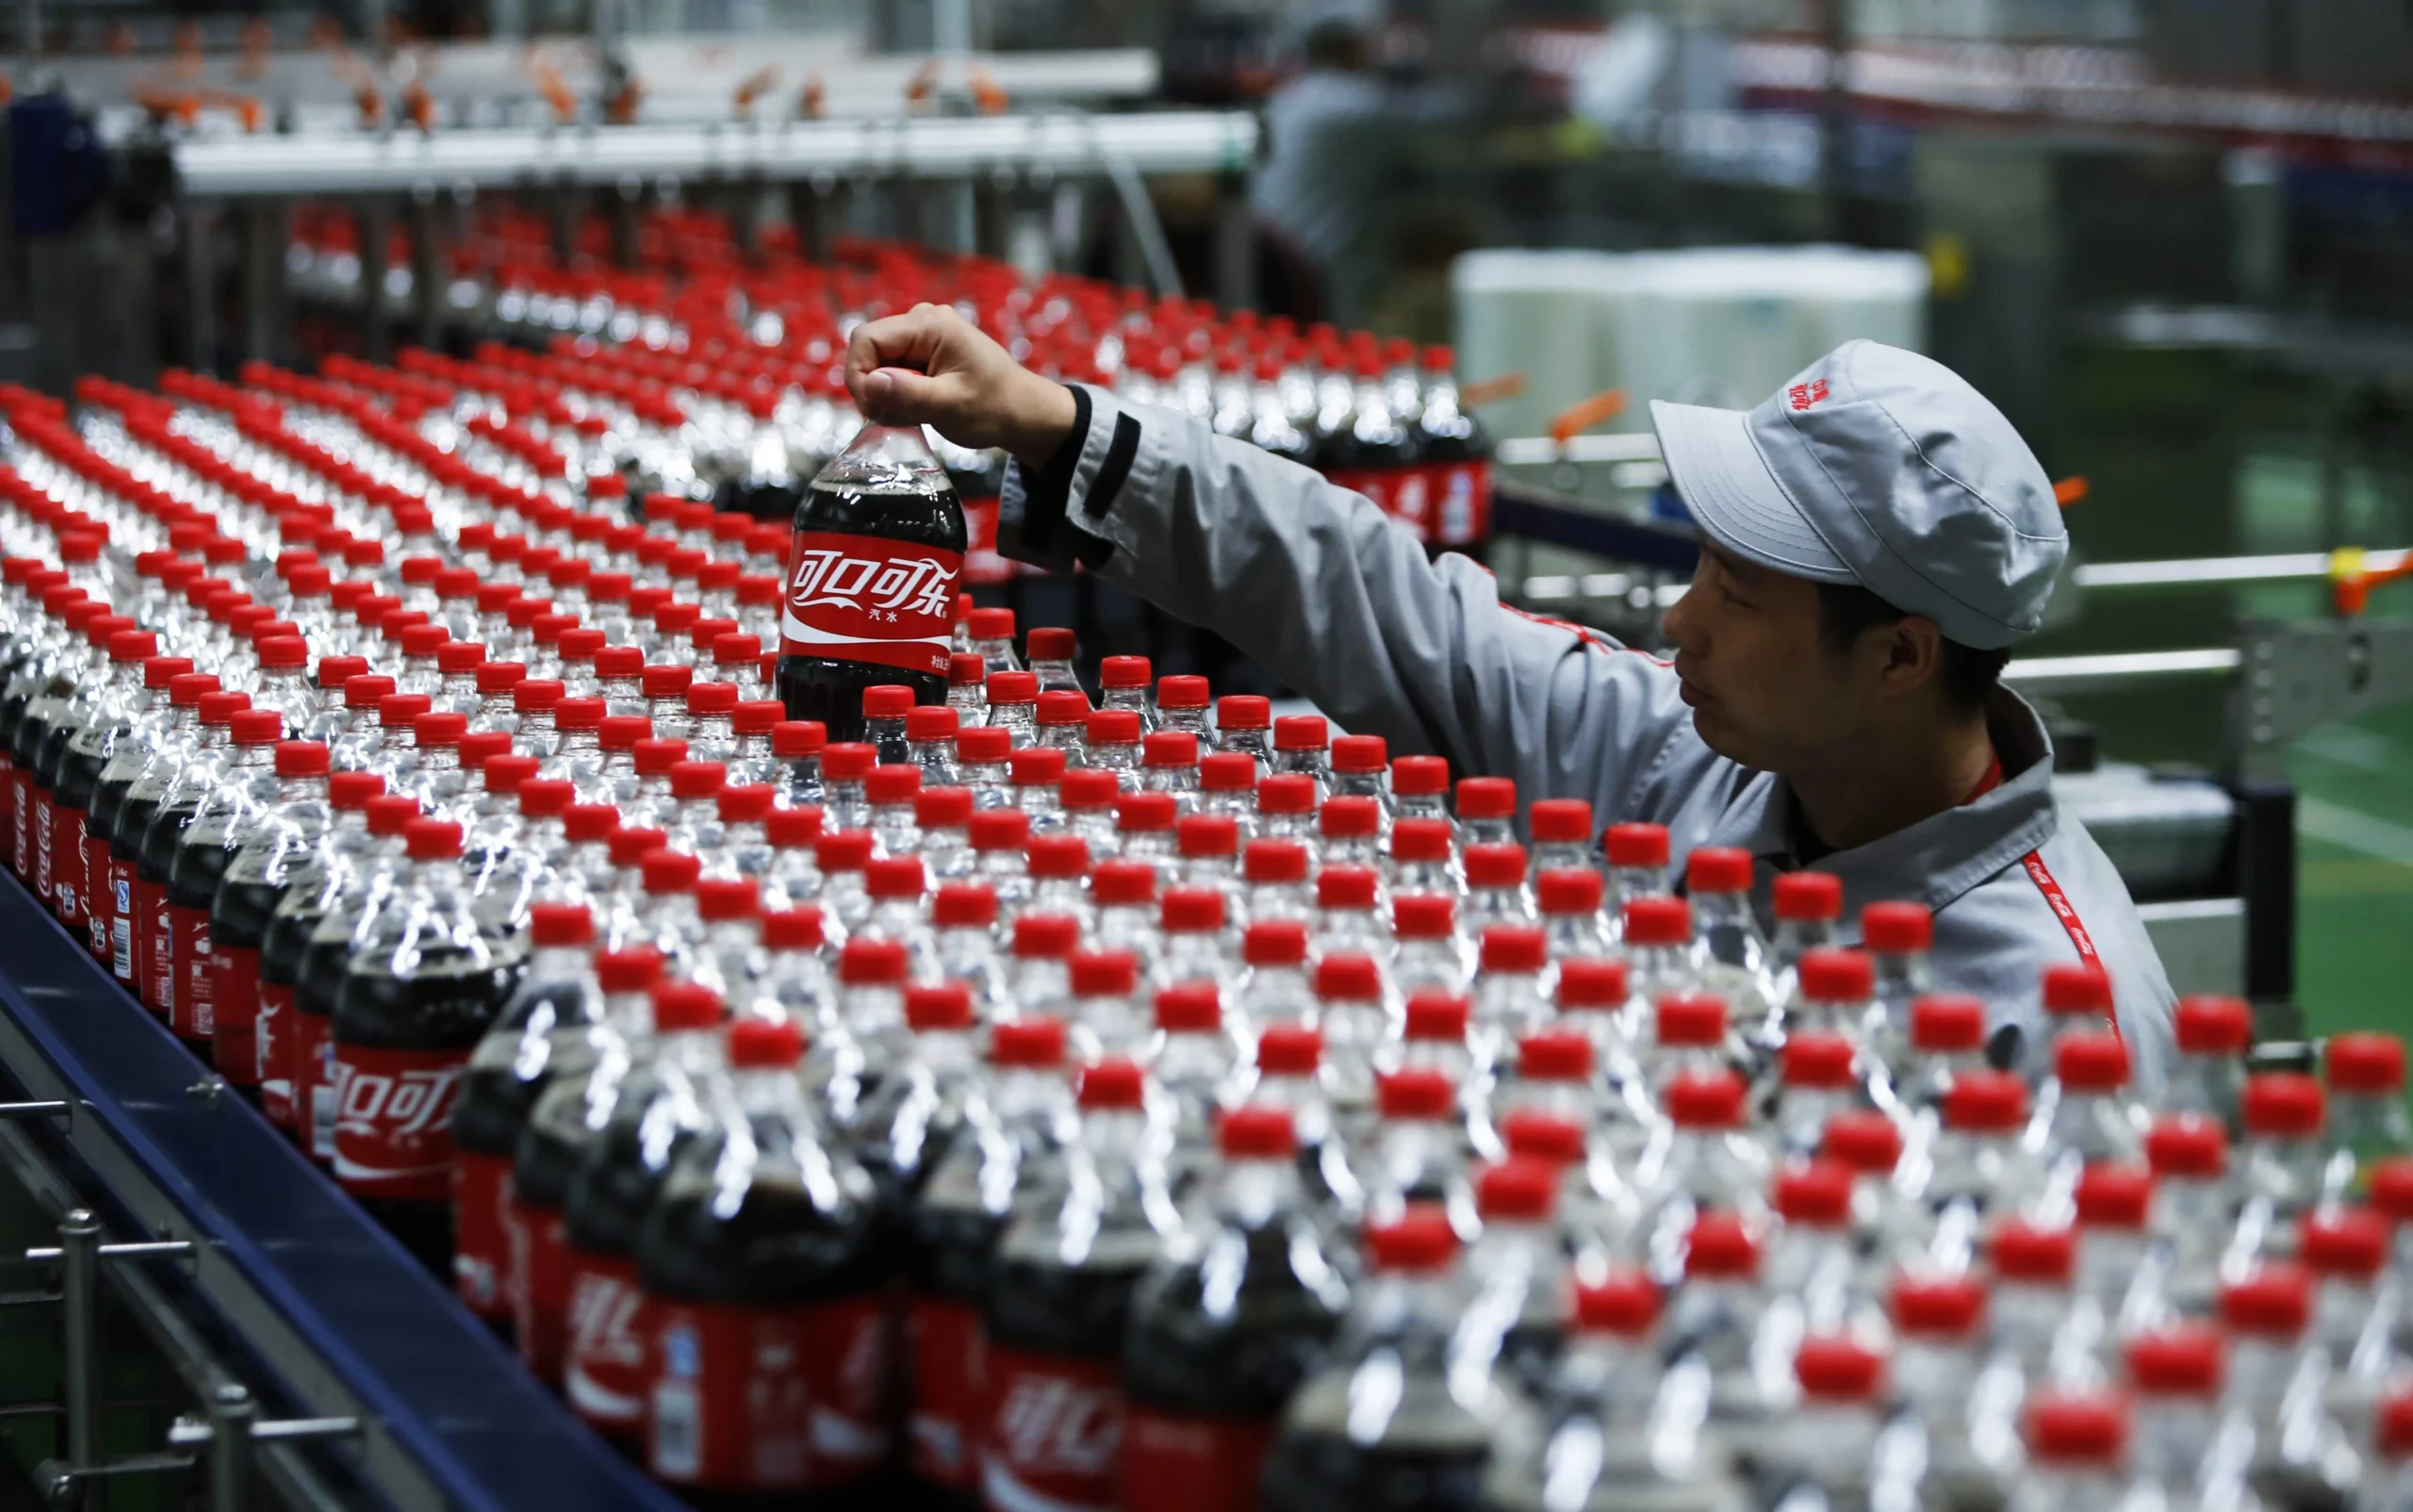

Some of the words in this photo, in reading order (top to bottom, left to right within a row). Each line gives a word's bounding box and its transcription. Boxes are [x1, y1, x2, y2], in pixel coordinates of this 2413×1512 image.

[793, 550, 959, 617] 可口可乐
[869, 608, 897, 623] 汽水
